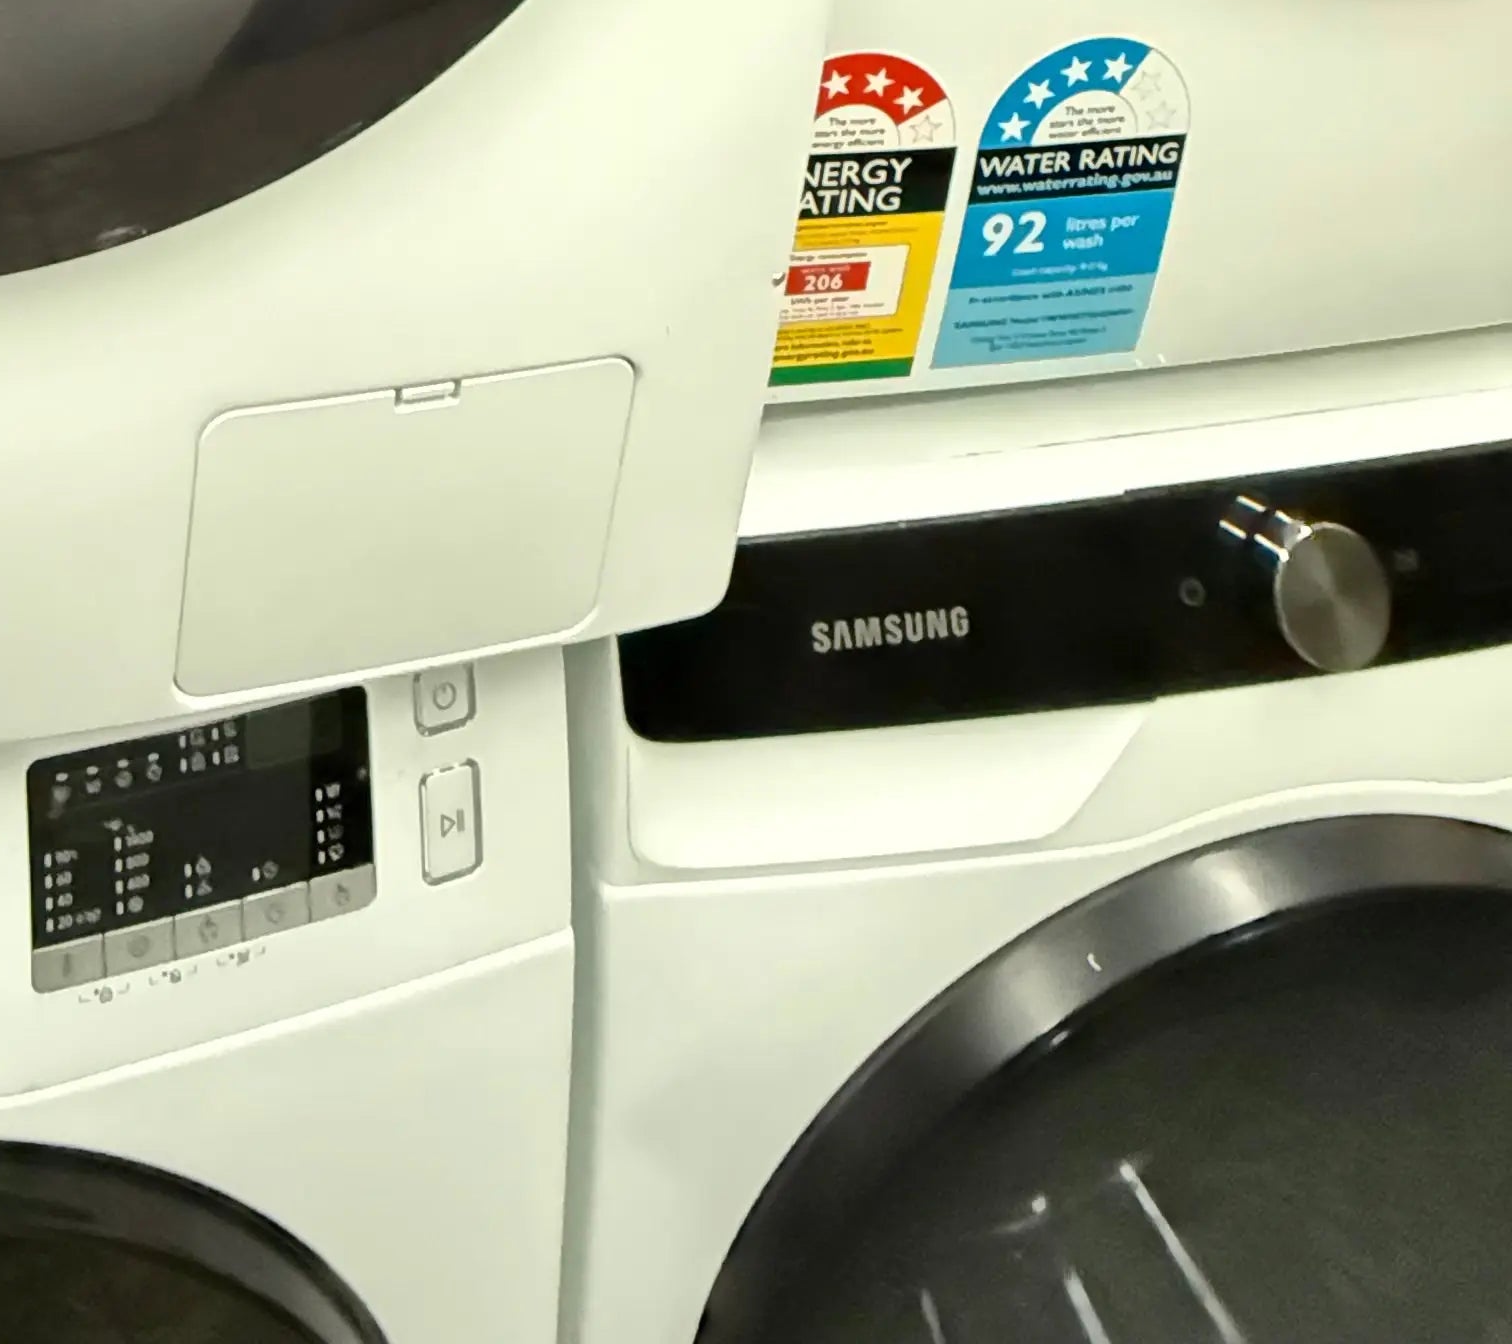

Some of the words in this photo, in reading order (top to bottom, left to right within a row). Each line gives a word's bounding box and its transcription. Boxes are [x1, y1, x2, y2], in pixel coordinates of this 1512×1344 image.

[980, 152, 1070, 178] WATER
[1079, 141, 1180, 170] RATING
[977, 170, 1173, 196] www.waterrating.gov.au
[982, 210, 1047, 256] 92
[1066, 217, 1107, 232] litres
[1110, 215, 1140, 232] per
[1063, 234, 1104, 250] wash
[803, 273, 843, 291] 206
[810, 605, 970, 654] SAMSUNG
